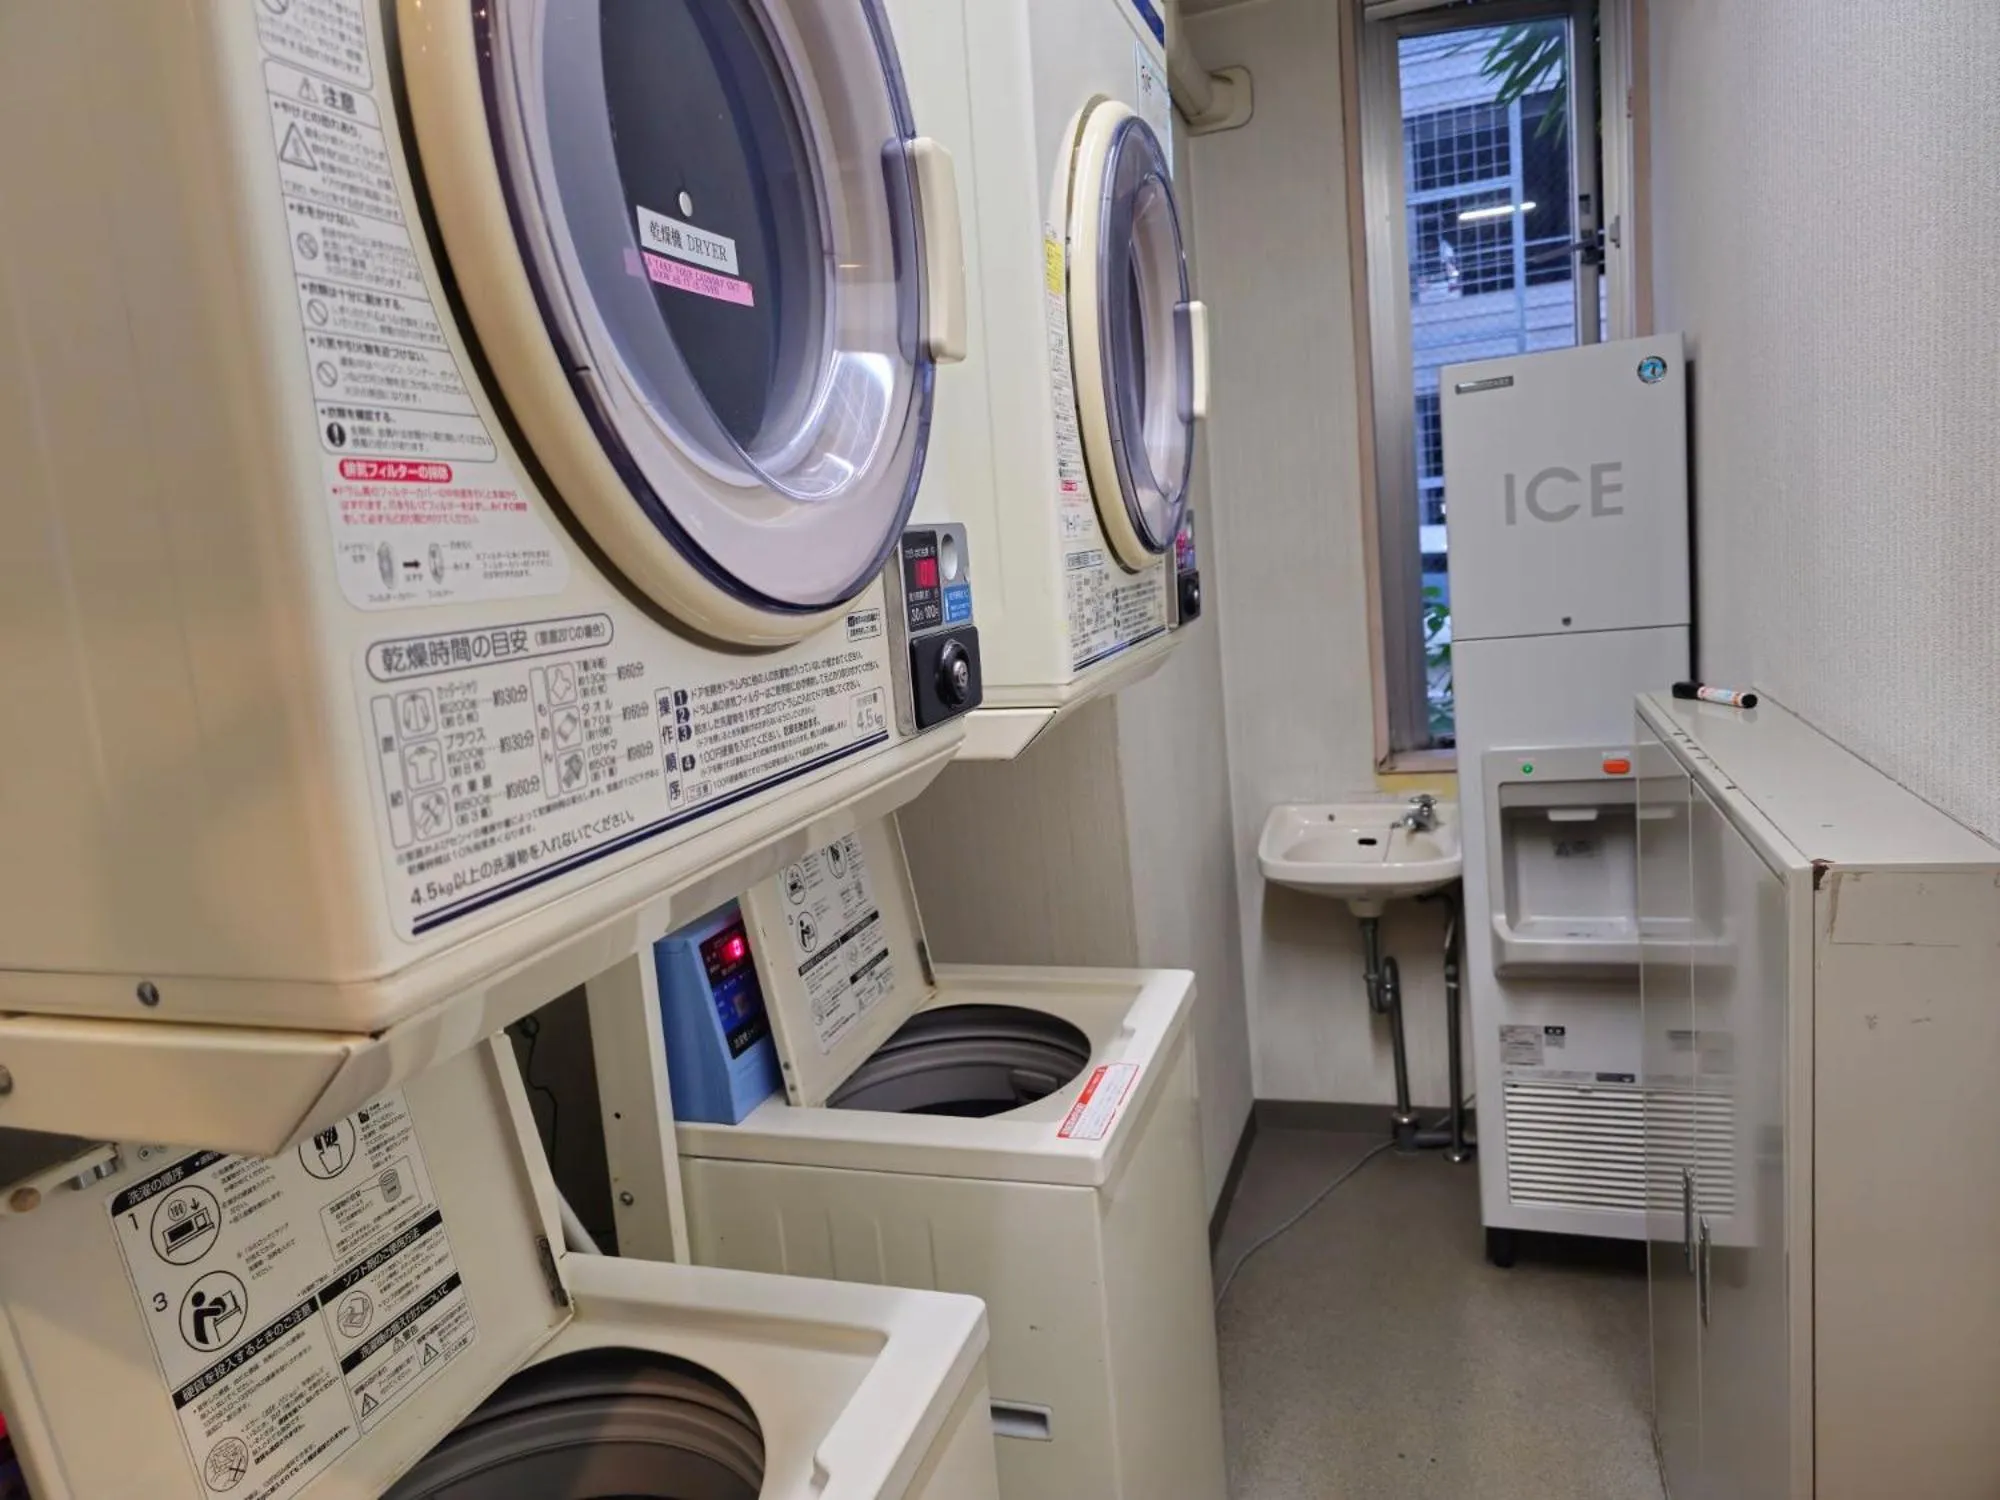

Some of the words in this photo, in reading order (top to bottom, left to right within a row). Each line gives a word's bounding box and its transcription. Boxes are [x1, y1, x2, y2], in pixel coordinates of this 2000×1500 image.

[322, 84, 357, 115] 注意
[650, 221, 683, 250] 乾燥機
[686, 234, 728, 262] DRYER
[1504, 462, 1624, 525] ICE
[382, 629, 529, 674] 乾燥時間の目安
[443, 727, 486, 749] ブラウス
[128, 1213, 138, 1231] 1
[152, 1292, 168, 1312] 3
